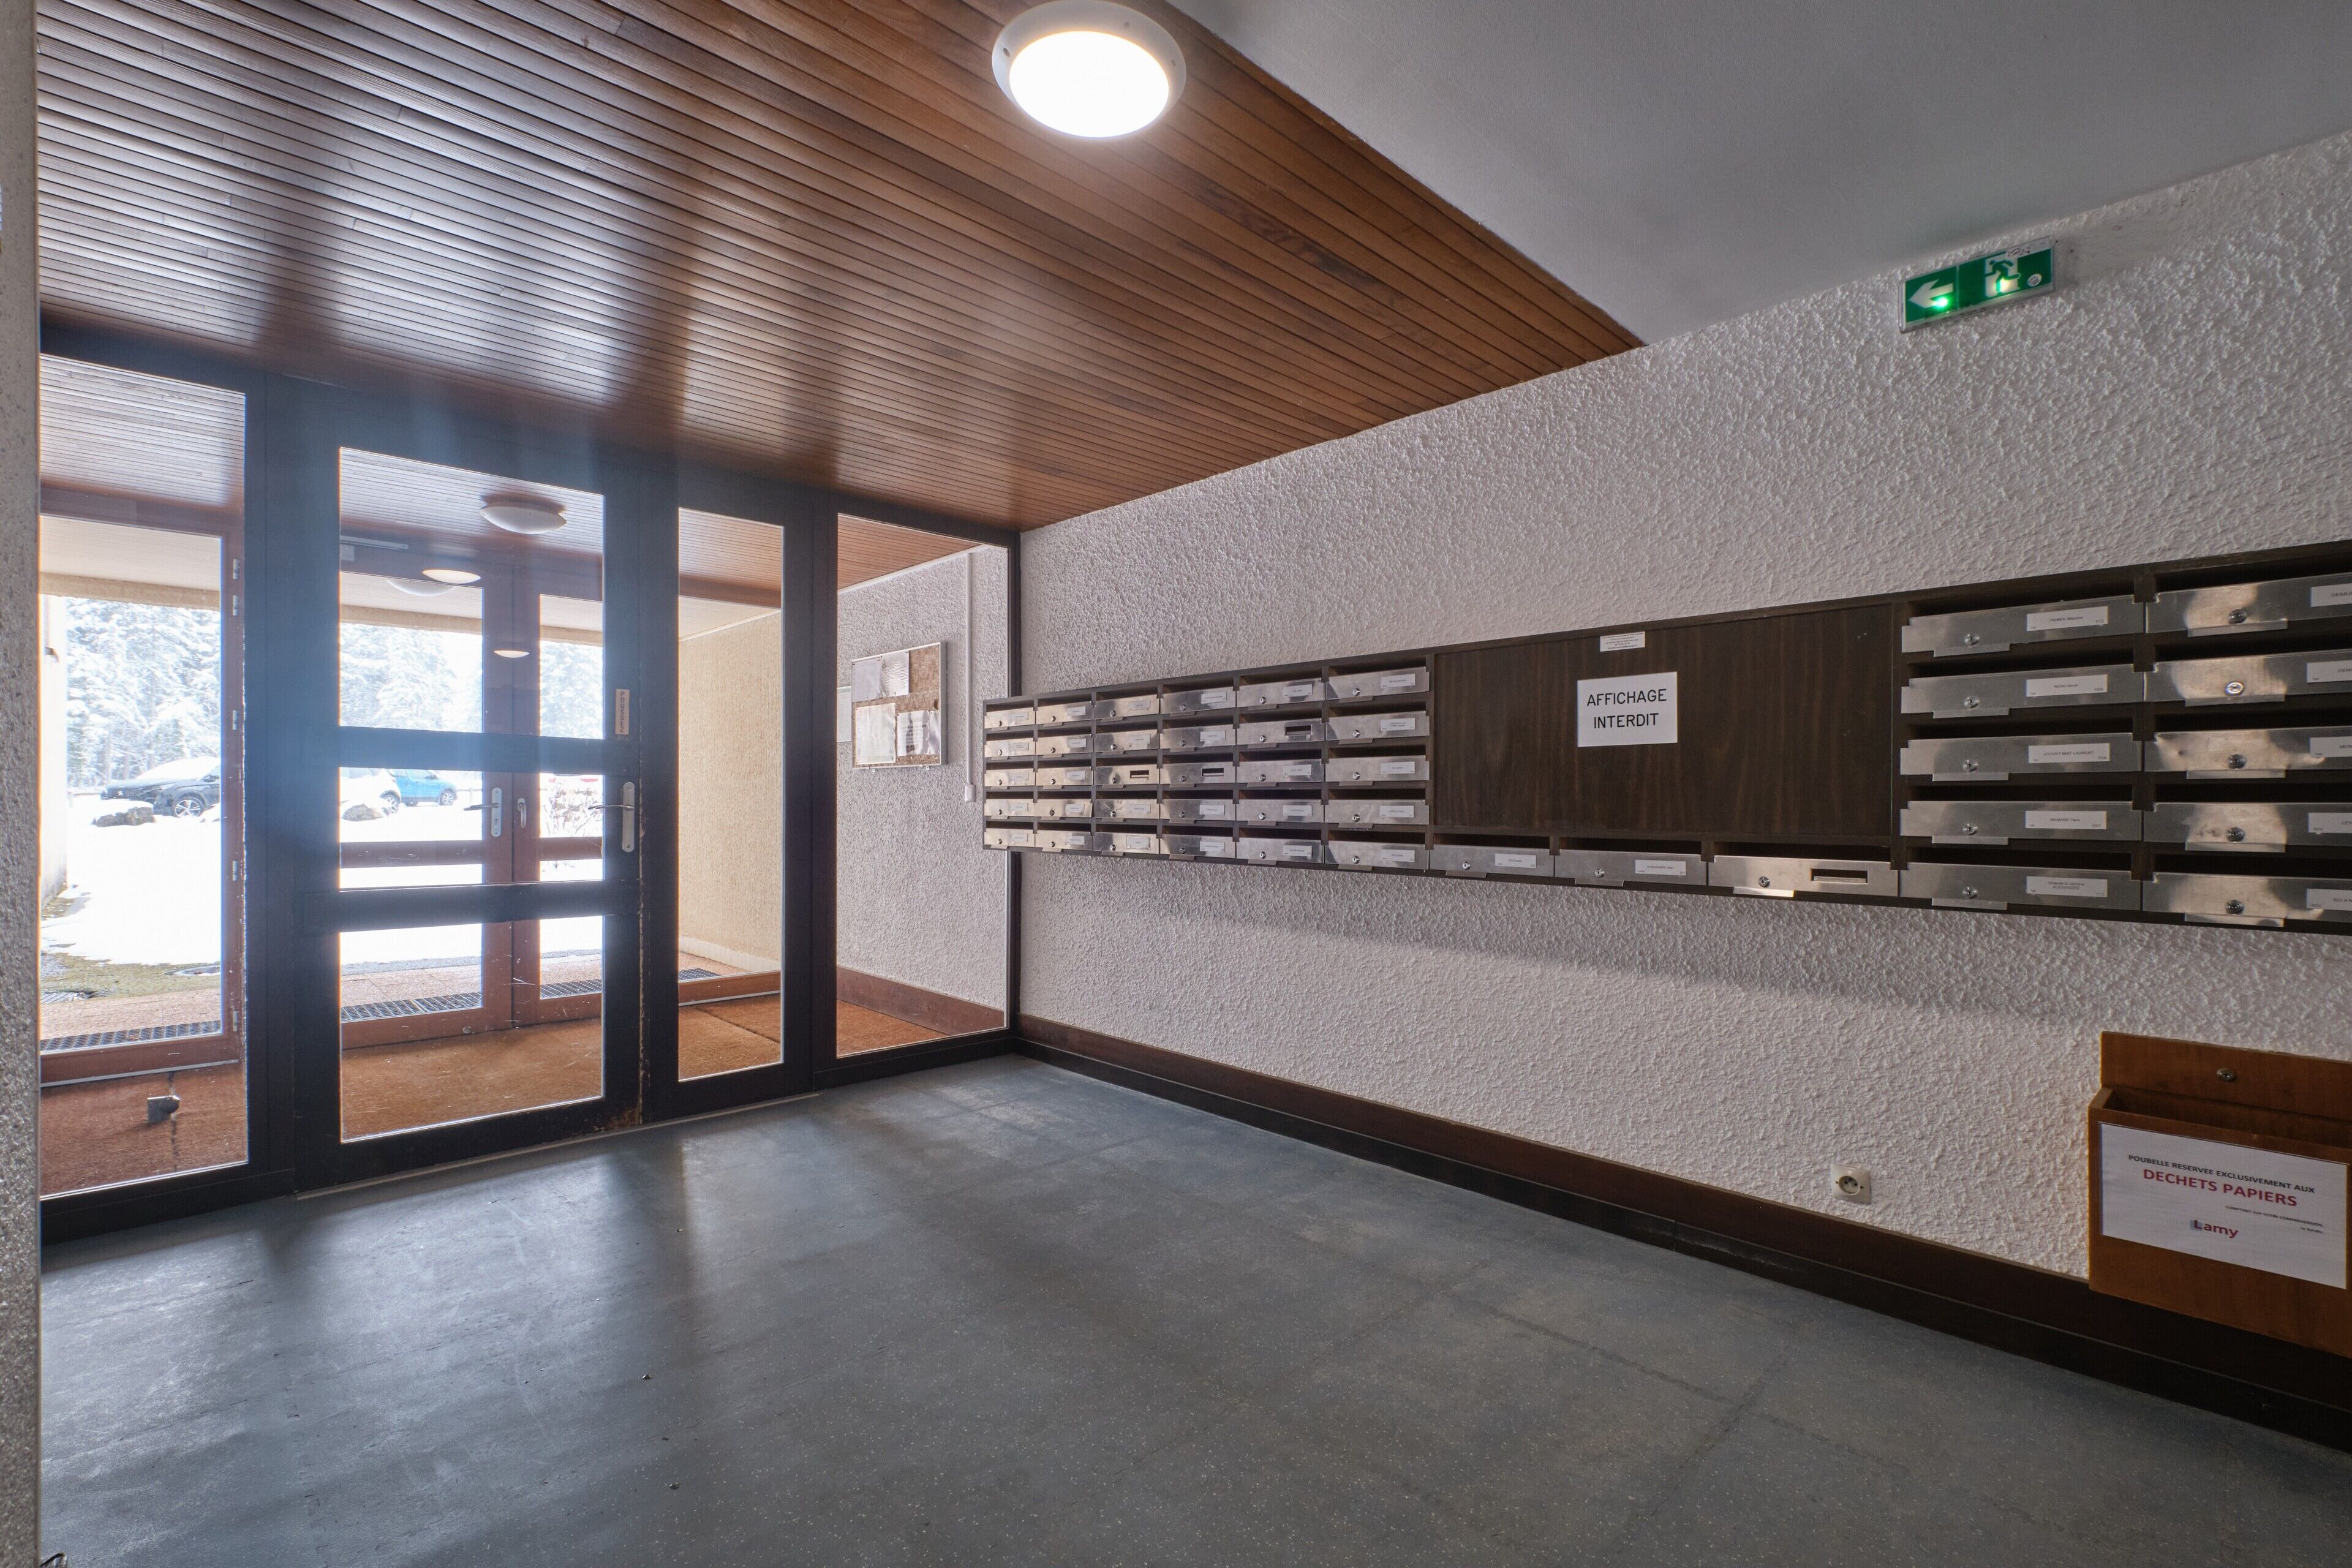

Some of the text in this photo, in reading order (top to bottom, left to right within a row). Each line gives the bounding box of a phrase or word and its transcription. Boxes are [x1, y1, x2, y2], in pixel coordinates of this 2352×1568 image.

[1587, 688, 1667, 707] AFFICHAGE
[1594, 712, 1659, 729] INTERDIT
[2128, 1155, 2315, 1194] POUBELLE RESERVEE EXCLUSIVEMENT AUX
[2143, 1169, 2297, 1207] DECHETS PAPIERS
[2194, 1219, 2239, 1238] Lamy
